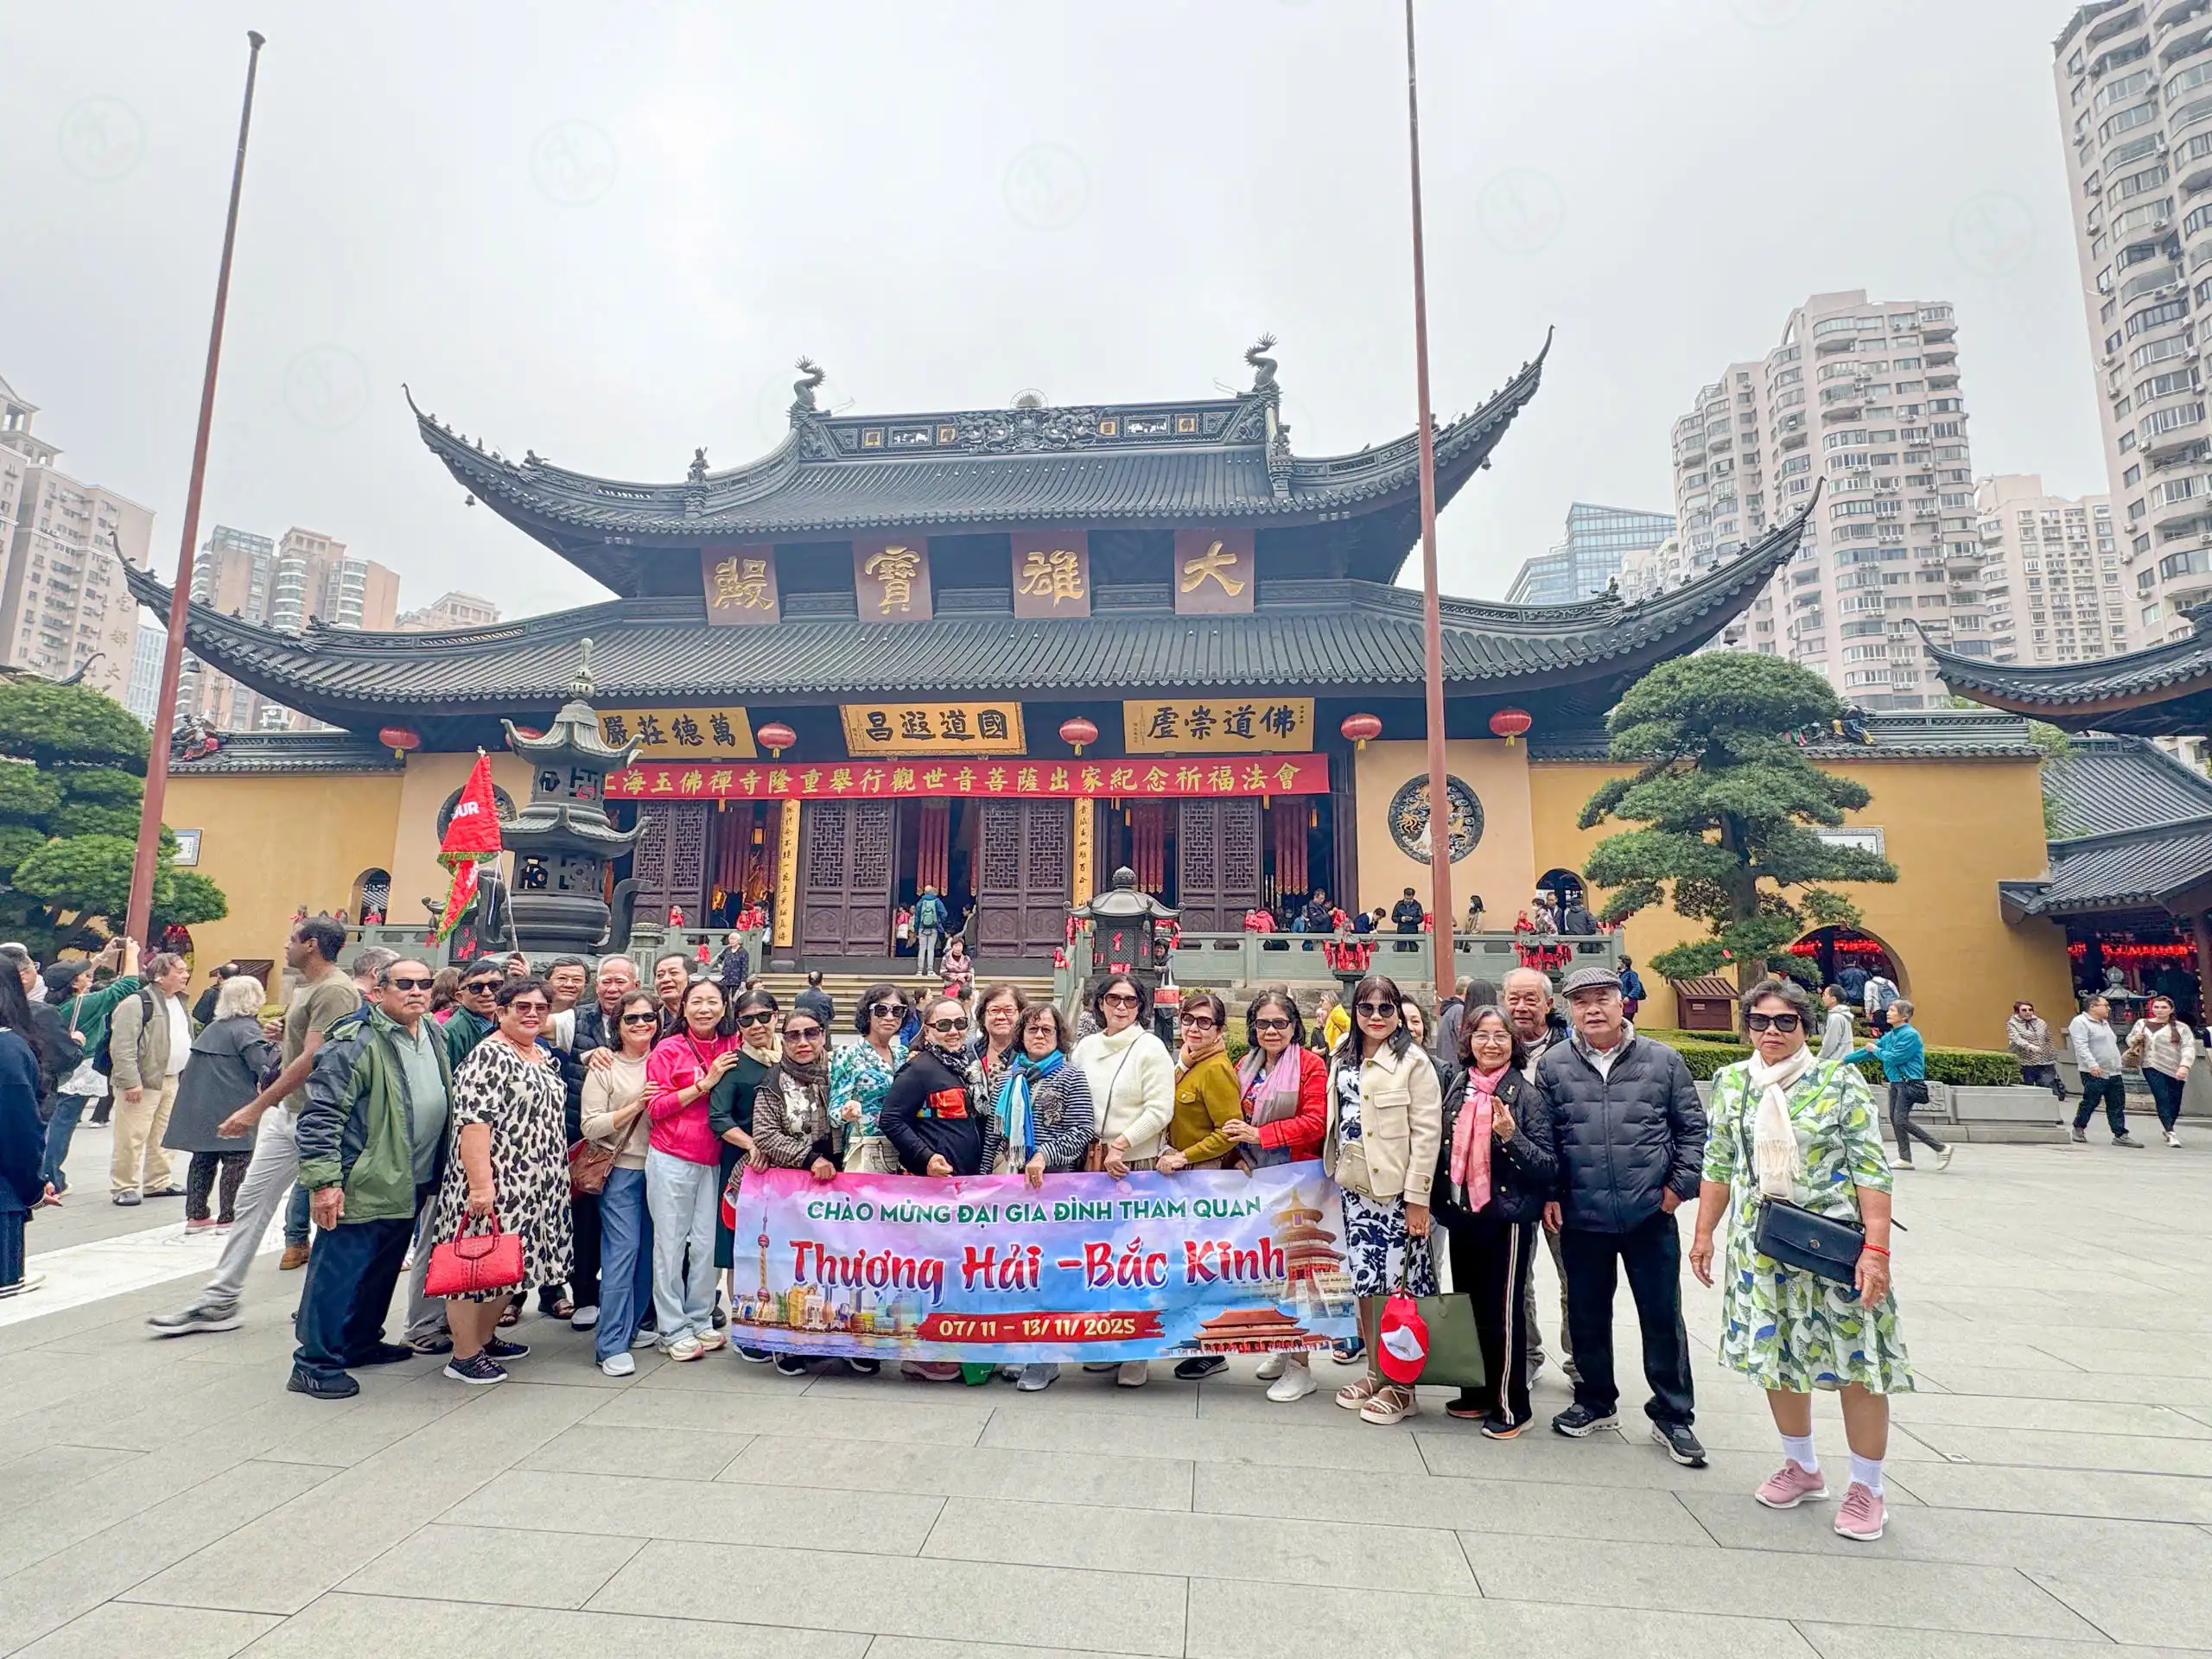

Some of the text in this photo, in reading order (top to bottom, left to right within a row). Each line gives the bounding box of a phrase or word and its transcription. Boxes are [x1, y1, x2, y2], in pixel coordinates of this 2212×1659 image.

[807, 1197, 874, 1222] CHÀO
[957, 1204, 999, 1229] ĐẠI
[1005, 1202, 1047, 1223] GIA
[1053, 1196, 1112, 1222] ĐÌNH
[1119, 1198, 1186, 1220] THAM
[1193, 1195, 1262, 1219] QUAN
[790, 1240, 944, 1306] Thượng
[962, 1243, 1042, 1290] Hải
[1184, 1236, 1287, 1284] Kinh
